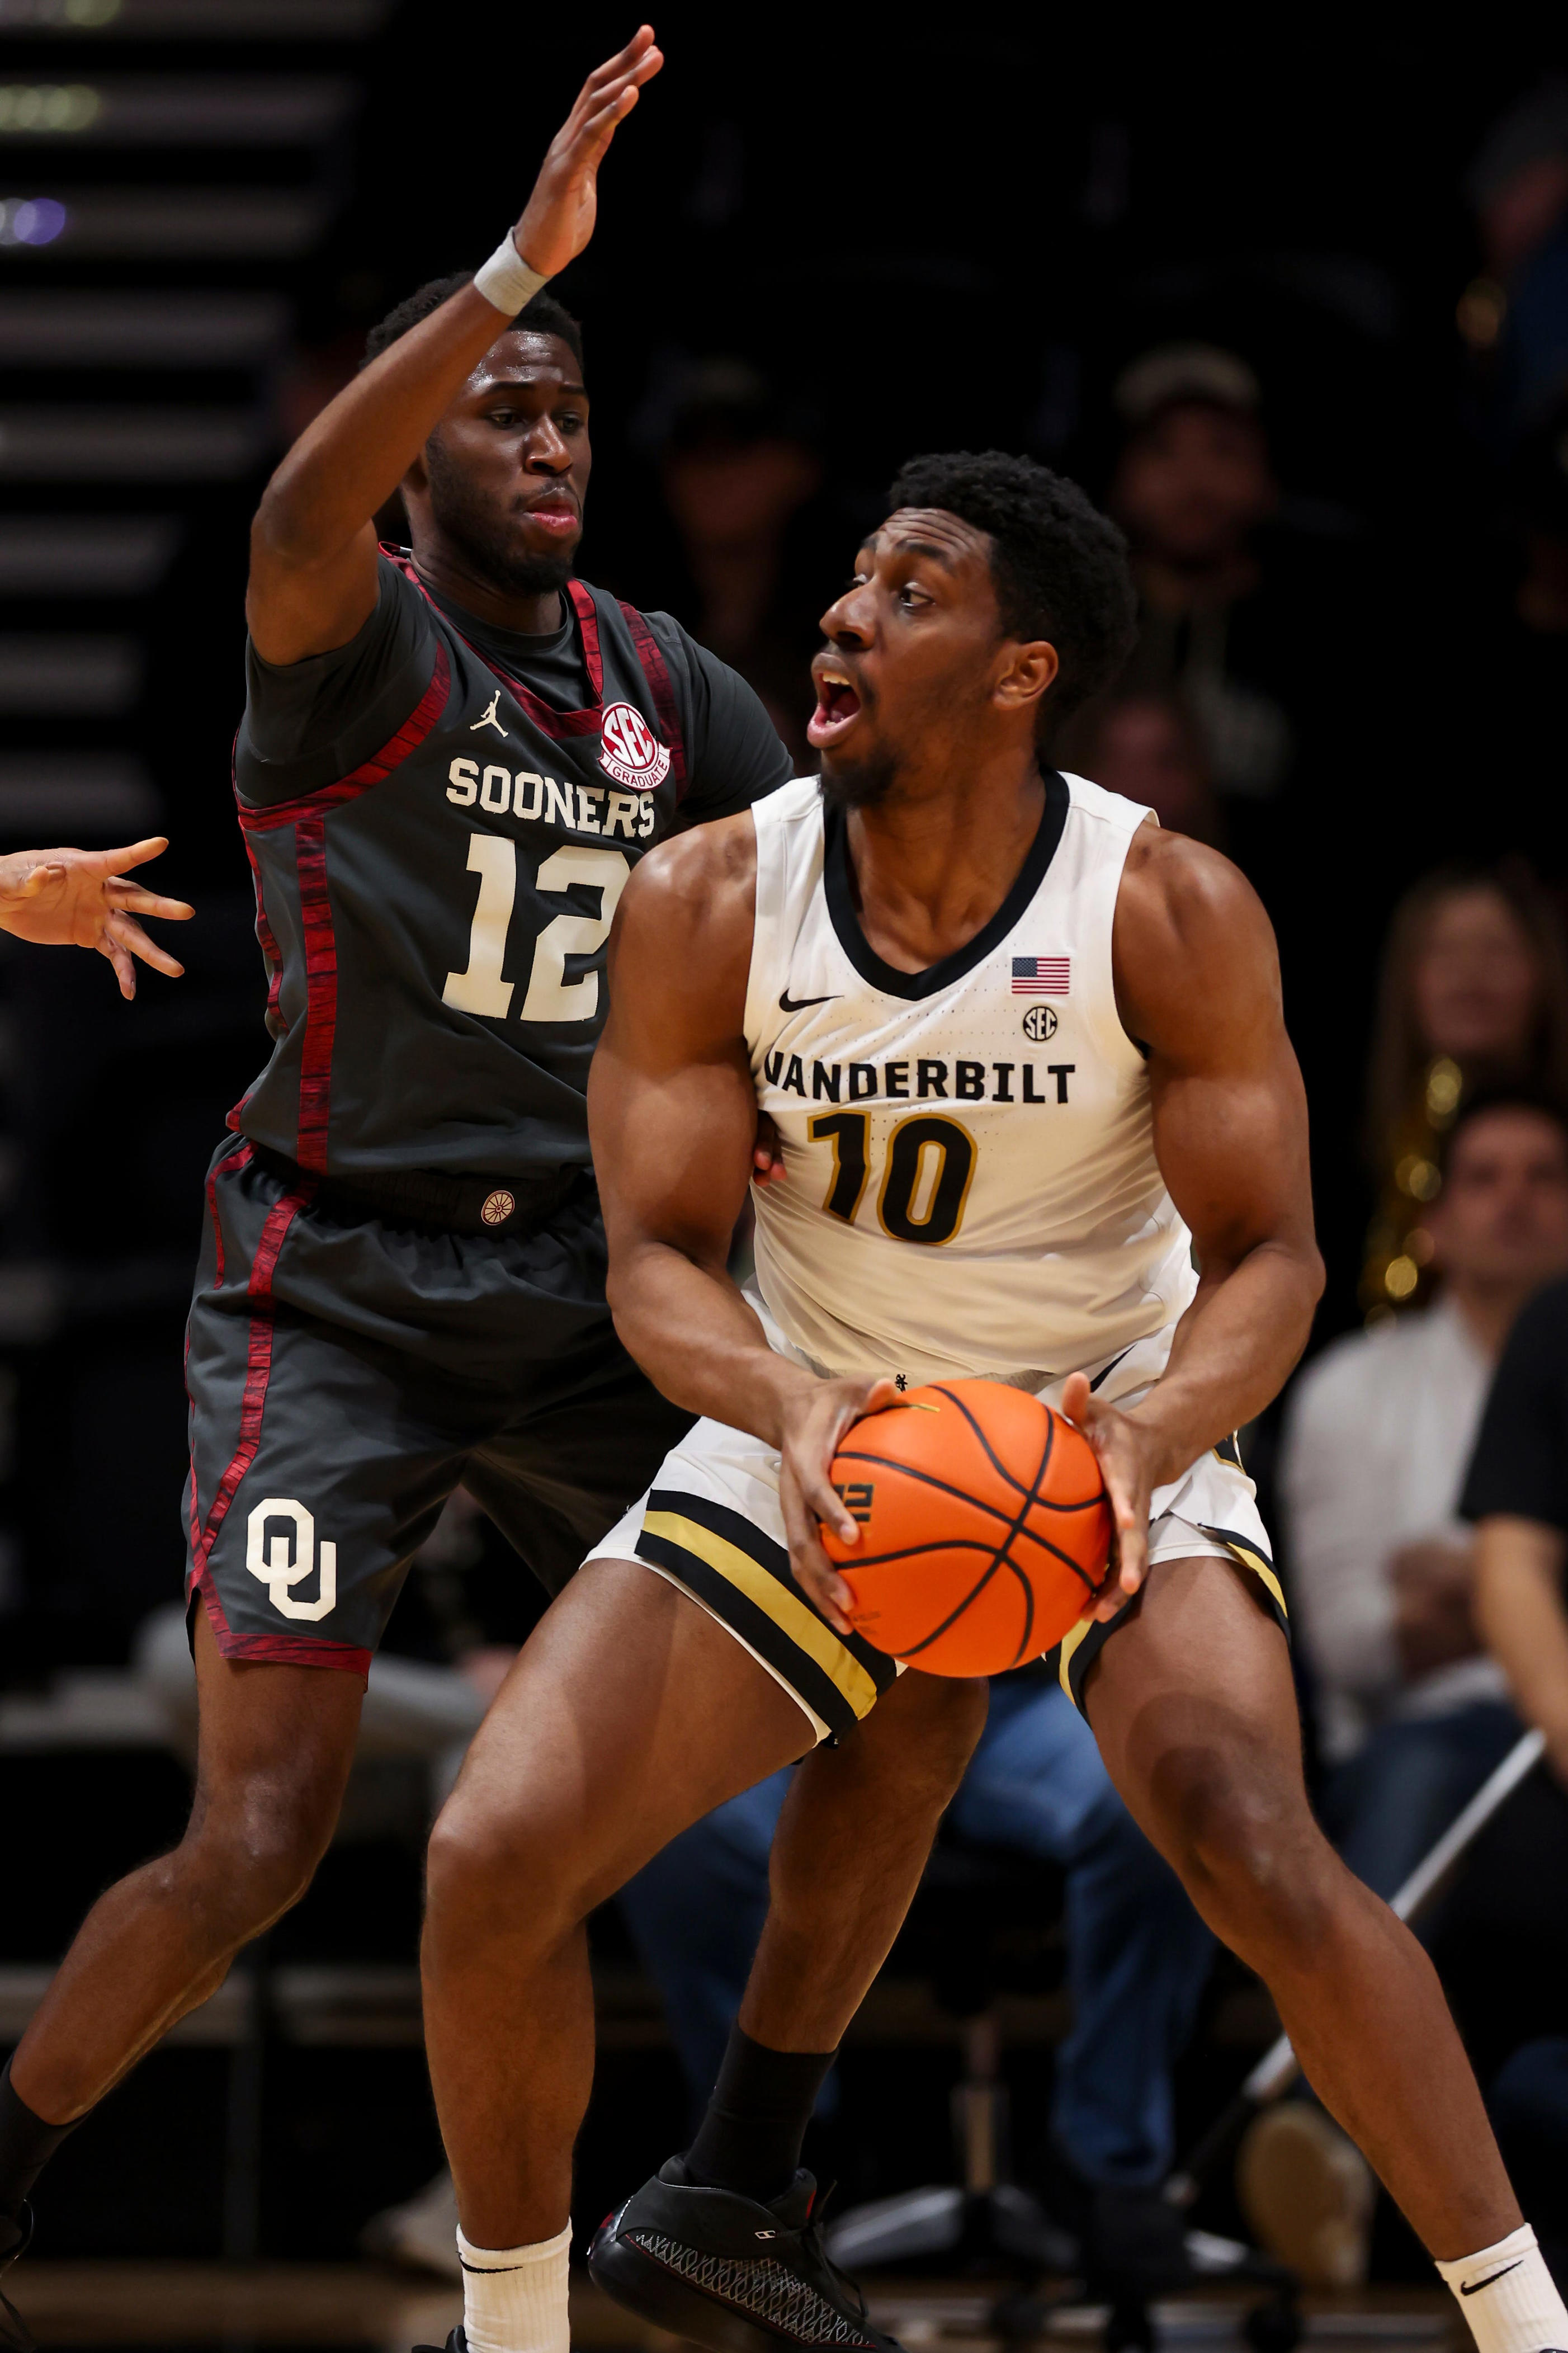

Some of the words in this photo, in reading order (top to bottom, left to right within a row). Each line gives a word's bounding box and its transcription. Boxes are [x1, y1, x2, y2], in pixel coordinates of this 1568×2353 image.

[604, 708, 653, 767] SEC
[446, 757, 654, 838] SOONERS
[612, 760, 668, 787] GRADUATE
[442, 833, 631, 1022] 12
[1025, 1007, 1056, 1040] SEC
[764, 1051, 1075, 1104] VANDERBILT
[807, 1109, 978, 1246] 10
[246, 1498, 337, 1622] OU
